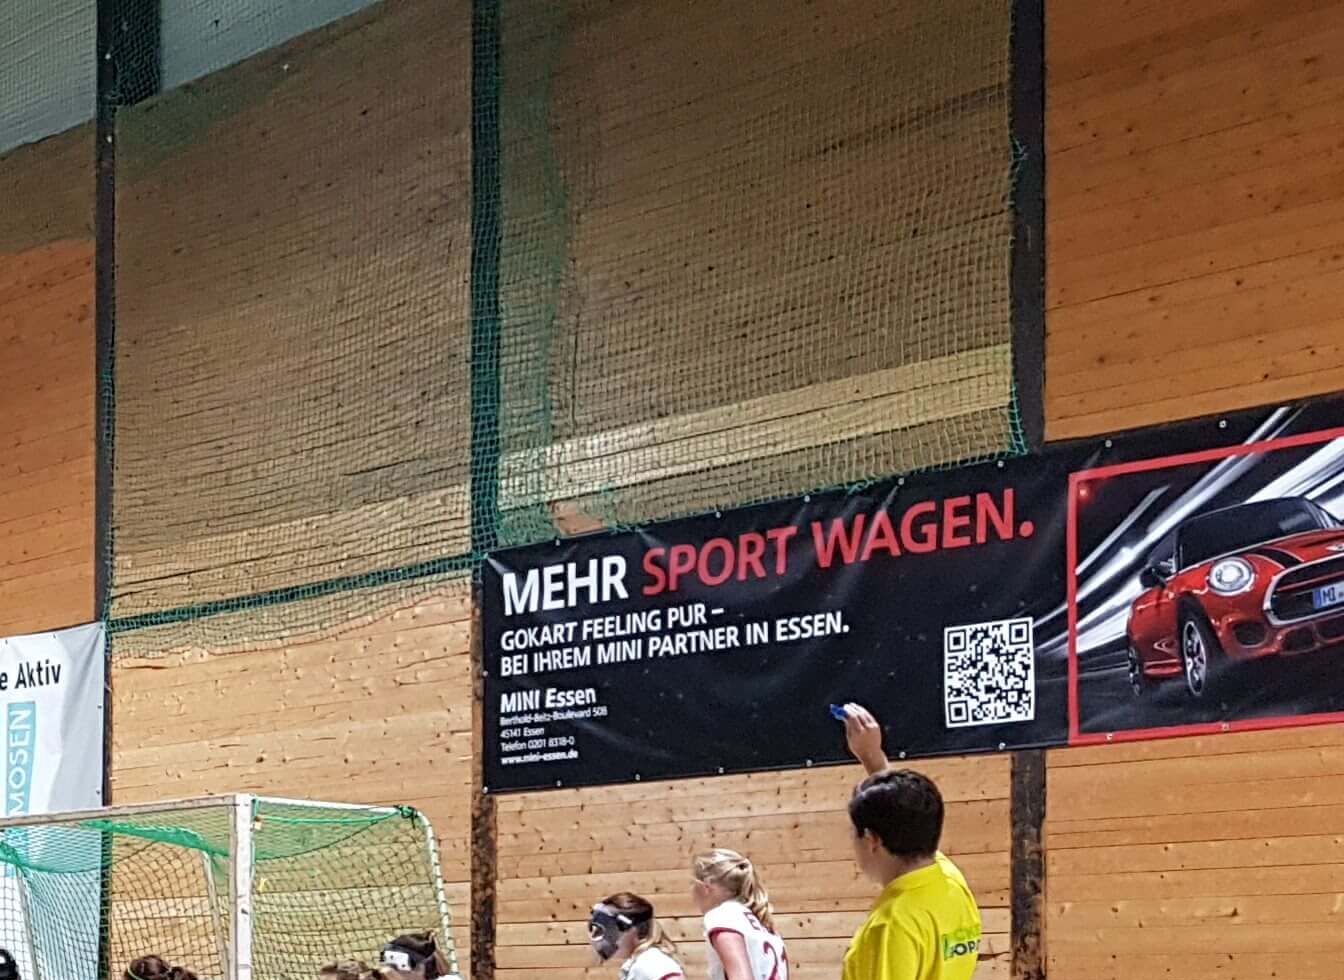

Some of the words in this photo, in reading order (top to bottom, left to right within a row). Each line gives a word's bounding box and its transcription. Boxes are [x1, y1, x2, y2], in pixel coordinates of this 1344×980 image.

[501, 555, 629, 617] MEHR
[641, 526, 798, 596] SPORT
[812, 488, 1034, 569] WAGEN.
[501, 621, 576, 651] GOKART
[582, 609, 661, 641] FEELING
[667, 603, 707, 627] PUR
[501, 655, 528, 676] BEI
[533, 645, 591, 672] IHREM
[597, 639, 642, 665] MINI
[648, 627, 739, 658] PARTNER
[746, 621, 769, 645] IN
[776, 610, 849, 641] ESSEN.
[14, 659, 61, 689] Aktiv
[500, 689, 540, 713] MINI
[545, 687, 596, 708] Essen
[523, 727, 545, 737] Essen
